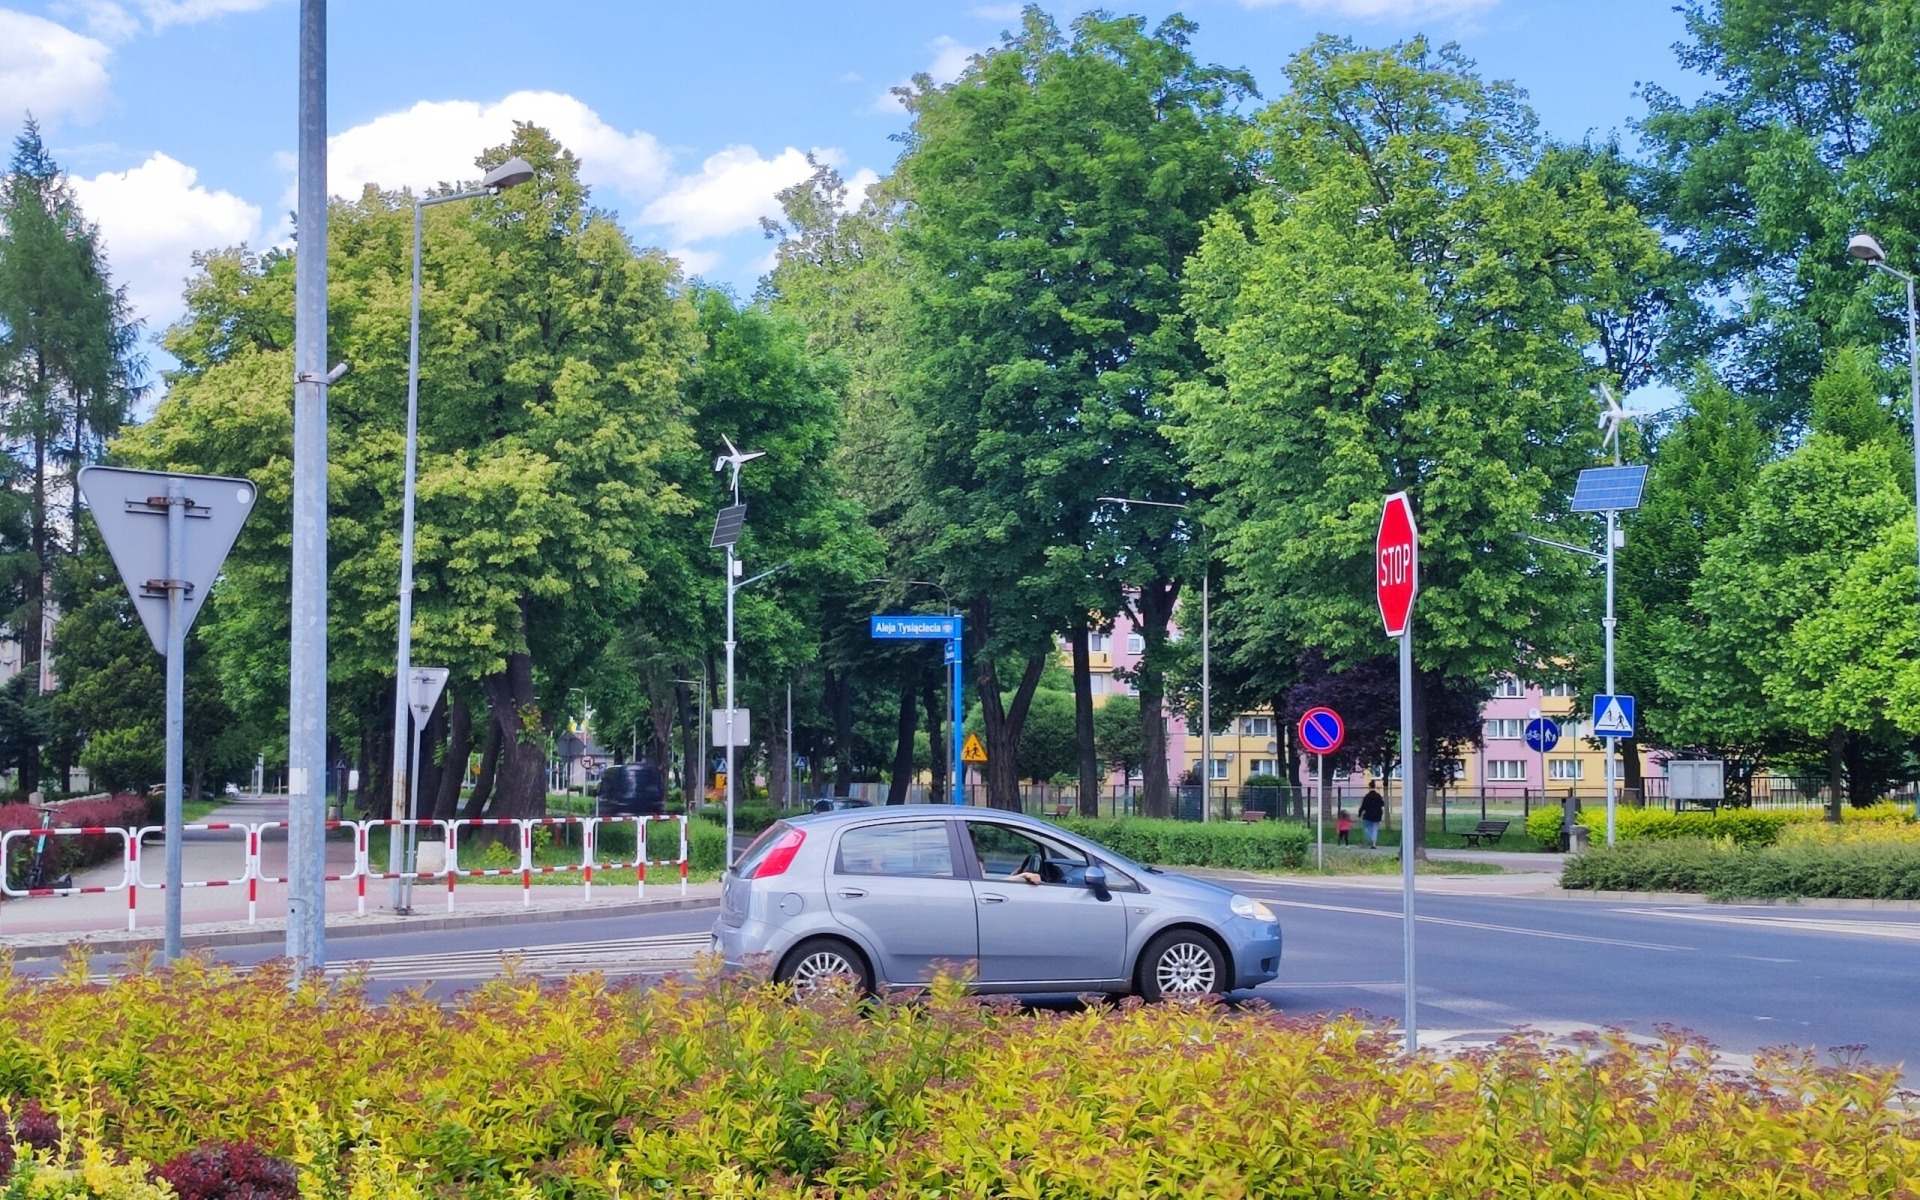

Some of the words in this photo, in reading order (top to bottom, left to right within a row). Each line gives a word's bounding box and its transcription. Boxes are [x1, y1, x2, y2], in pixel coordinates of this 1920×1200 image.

[1381, 543, 1411, 587] STOP
[876, 622, 896, 634] Aleja
[898, 622, 941, 634] Tysiąclecia
